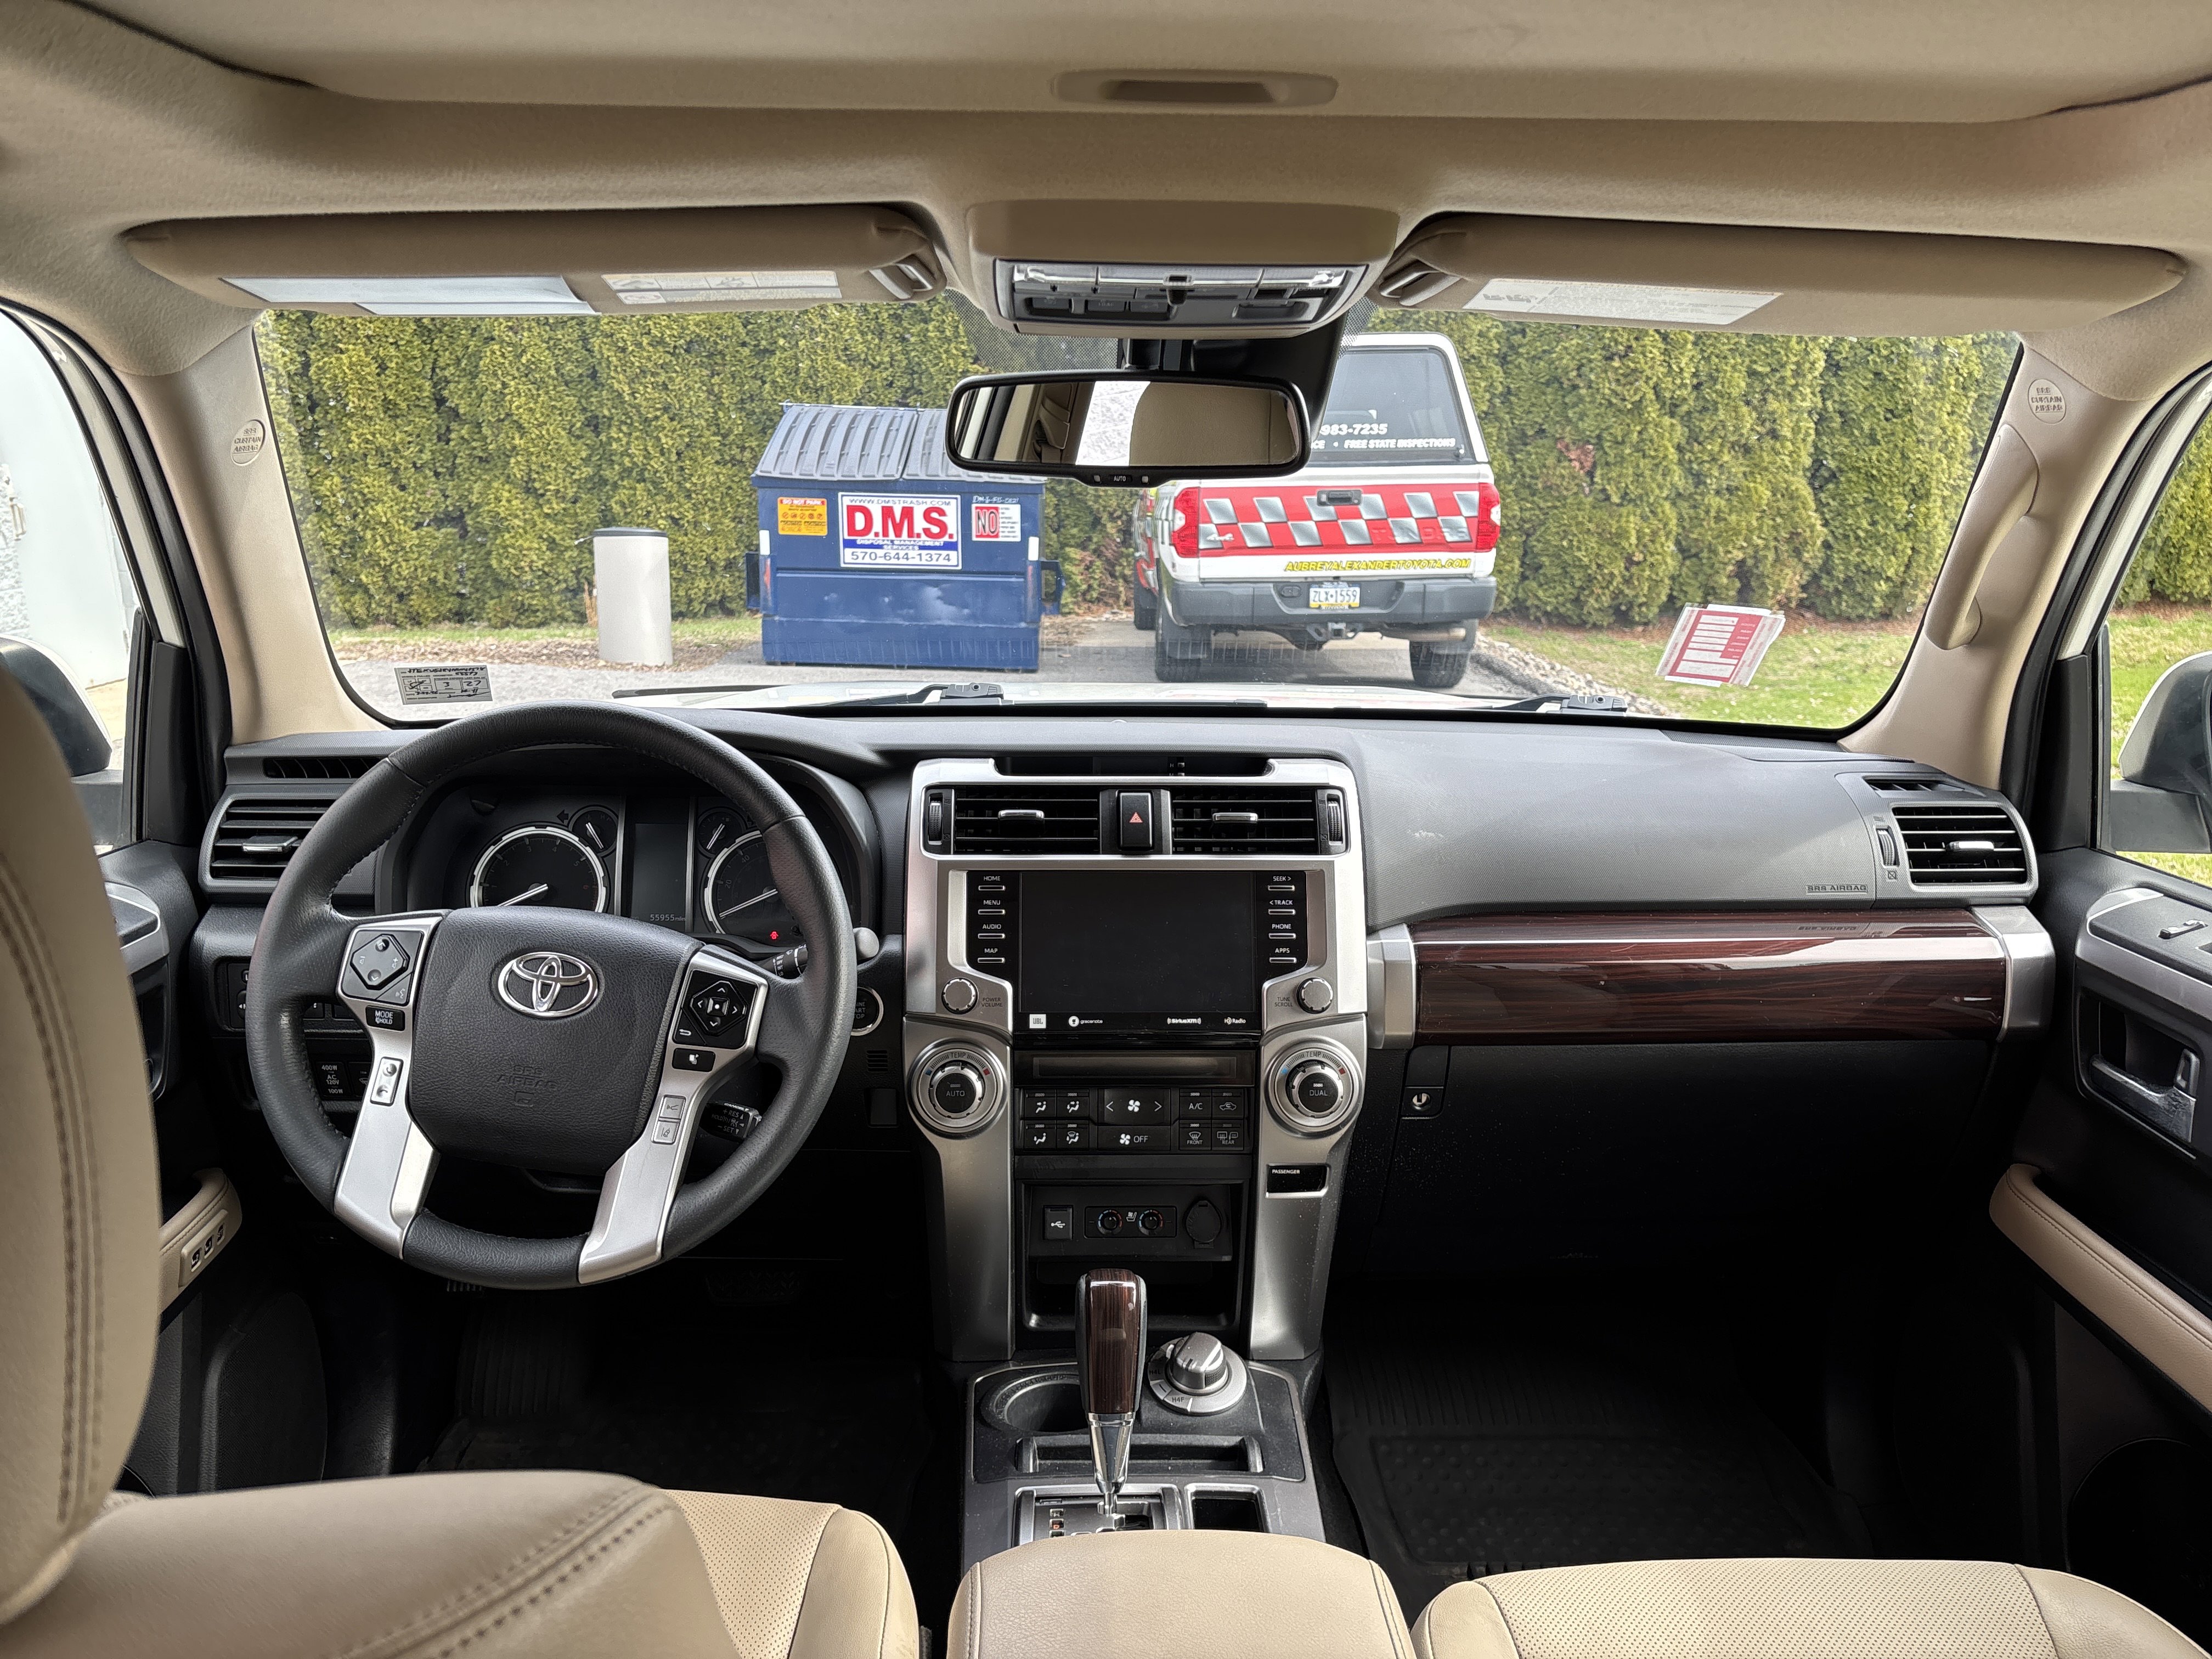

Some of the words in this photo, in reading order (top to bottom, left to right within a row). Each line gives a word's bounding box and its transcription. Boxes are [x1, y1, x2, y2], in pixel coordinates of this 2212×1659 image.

[1344, 439, 1368, 448] FREE
[1368, 439, 1396, 448] STATE
[1397, 438, 1455, 448] INSPECTIONS
[847, 504, 954, 540] D.M.S.
[975, 509, 999, 536] NO
[851, 551, 952, 562] 570-644-1374
[1284, 558, 1471, 572] AUBREYALEXANDERTOYOTA.COM
[741, 855, 750, 864] 40
[725, 879, 732, 889] 20
[375, 1010, 394, 1019] MODE
[728, 1110, 740, 1118] RES
